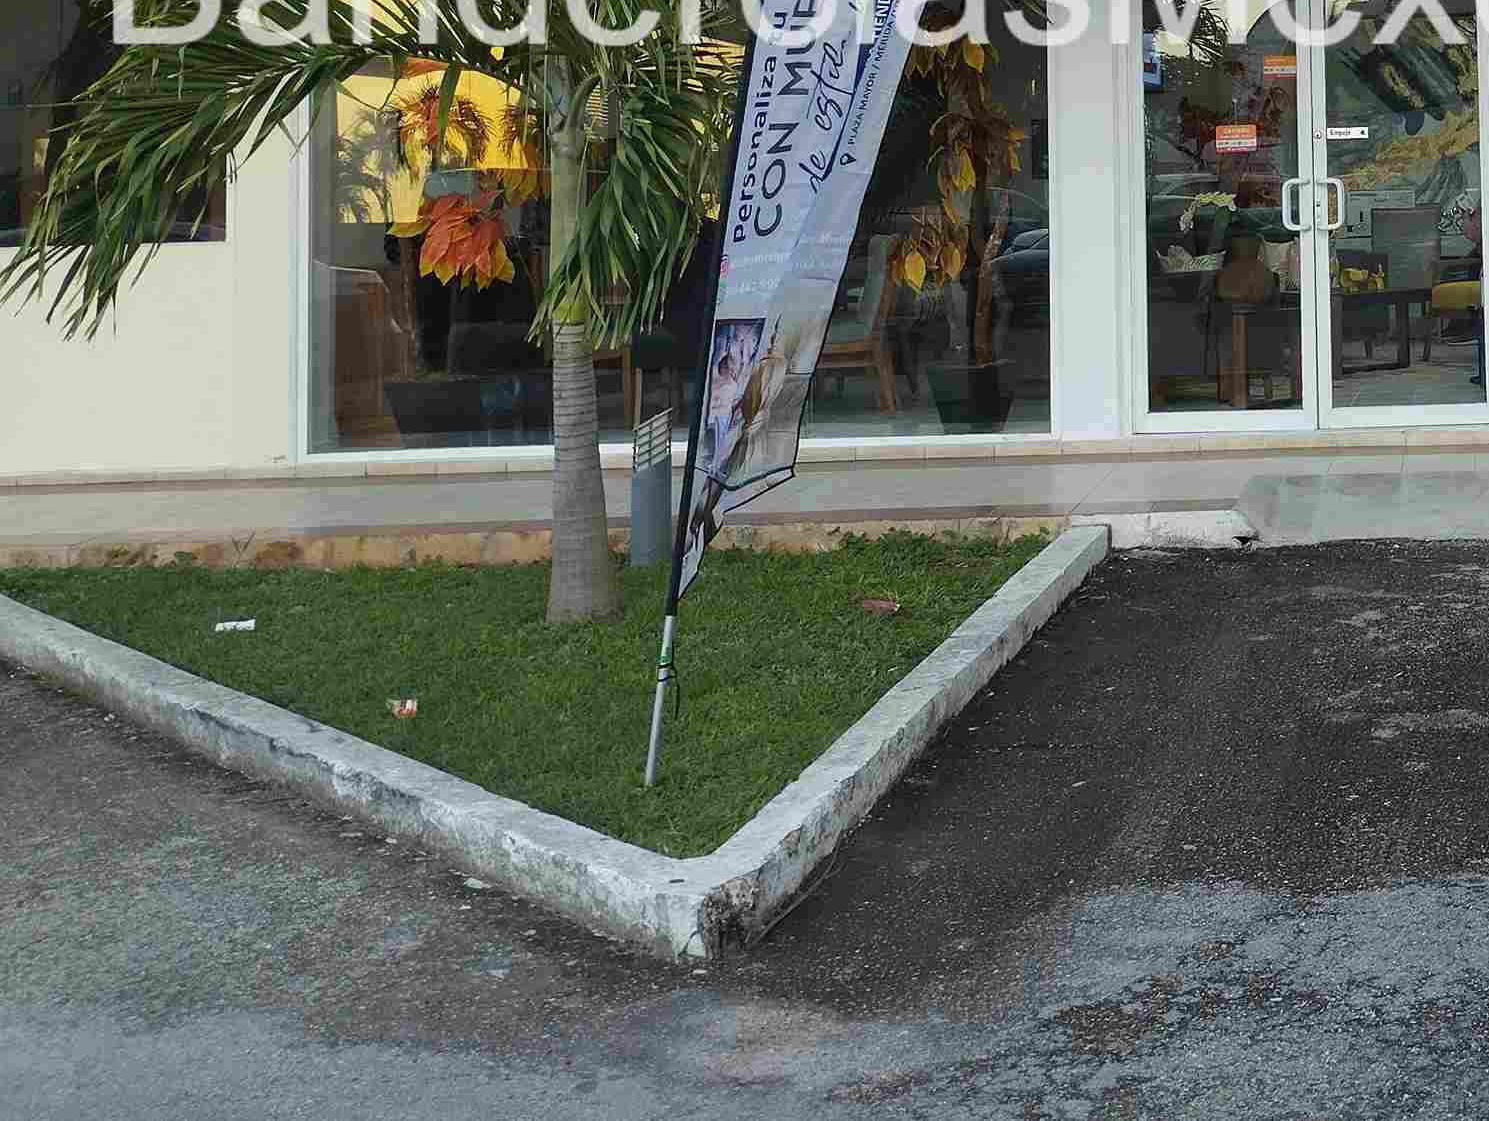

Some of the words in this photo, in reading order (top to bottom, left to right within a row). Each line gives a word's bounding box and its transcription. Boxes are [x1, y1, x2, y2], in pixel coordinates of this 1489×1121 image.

[732, 55, 777, 242] Personaliza
[859, 72, 877, 109] MAYOR
[754, 121, 800, 239] CON
